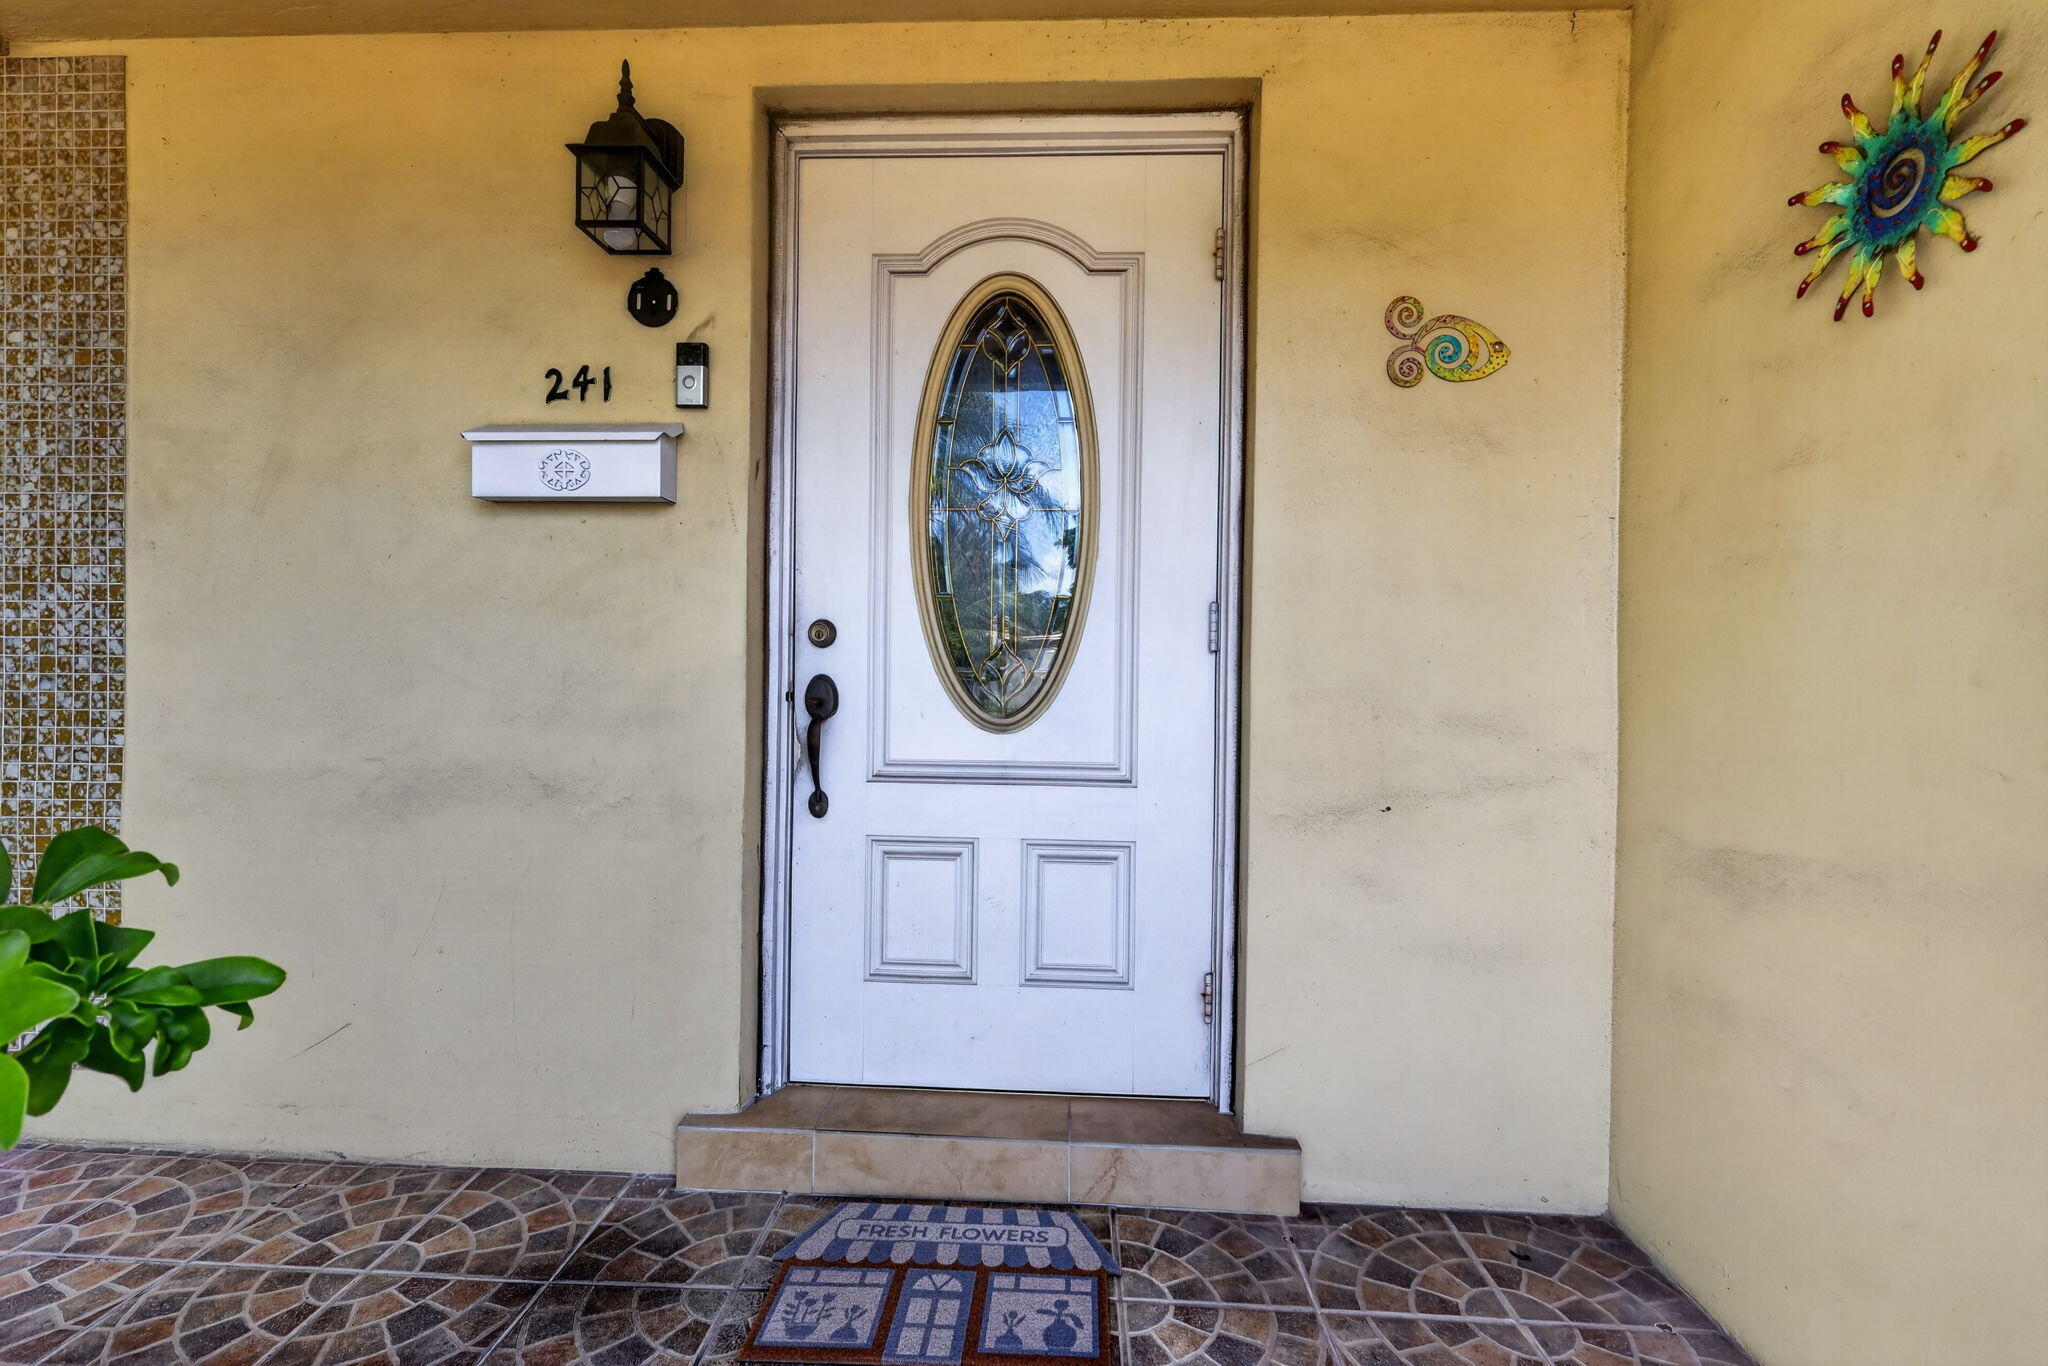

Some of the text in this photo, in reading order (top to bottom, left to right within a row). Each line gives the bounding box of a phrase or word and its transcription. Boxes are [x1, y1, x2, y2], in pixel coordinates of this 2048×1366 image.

[545, 364, 613, 405] 241
[856, 1223, 1050, 1244] FRESH FLOWERS
